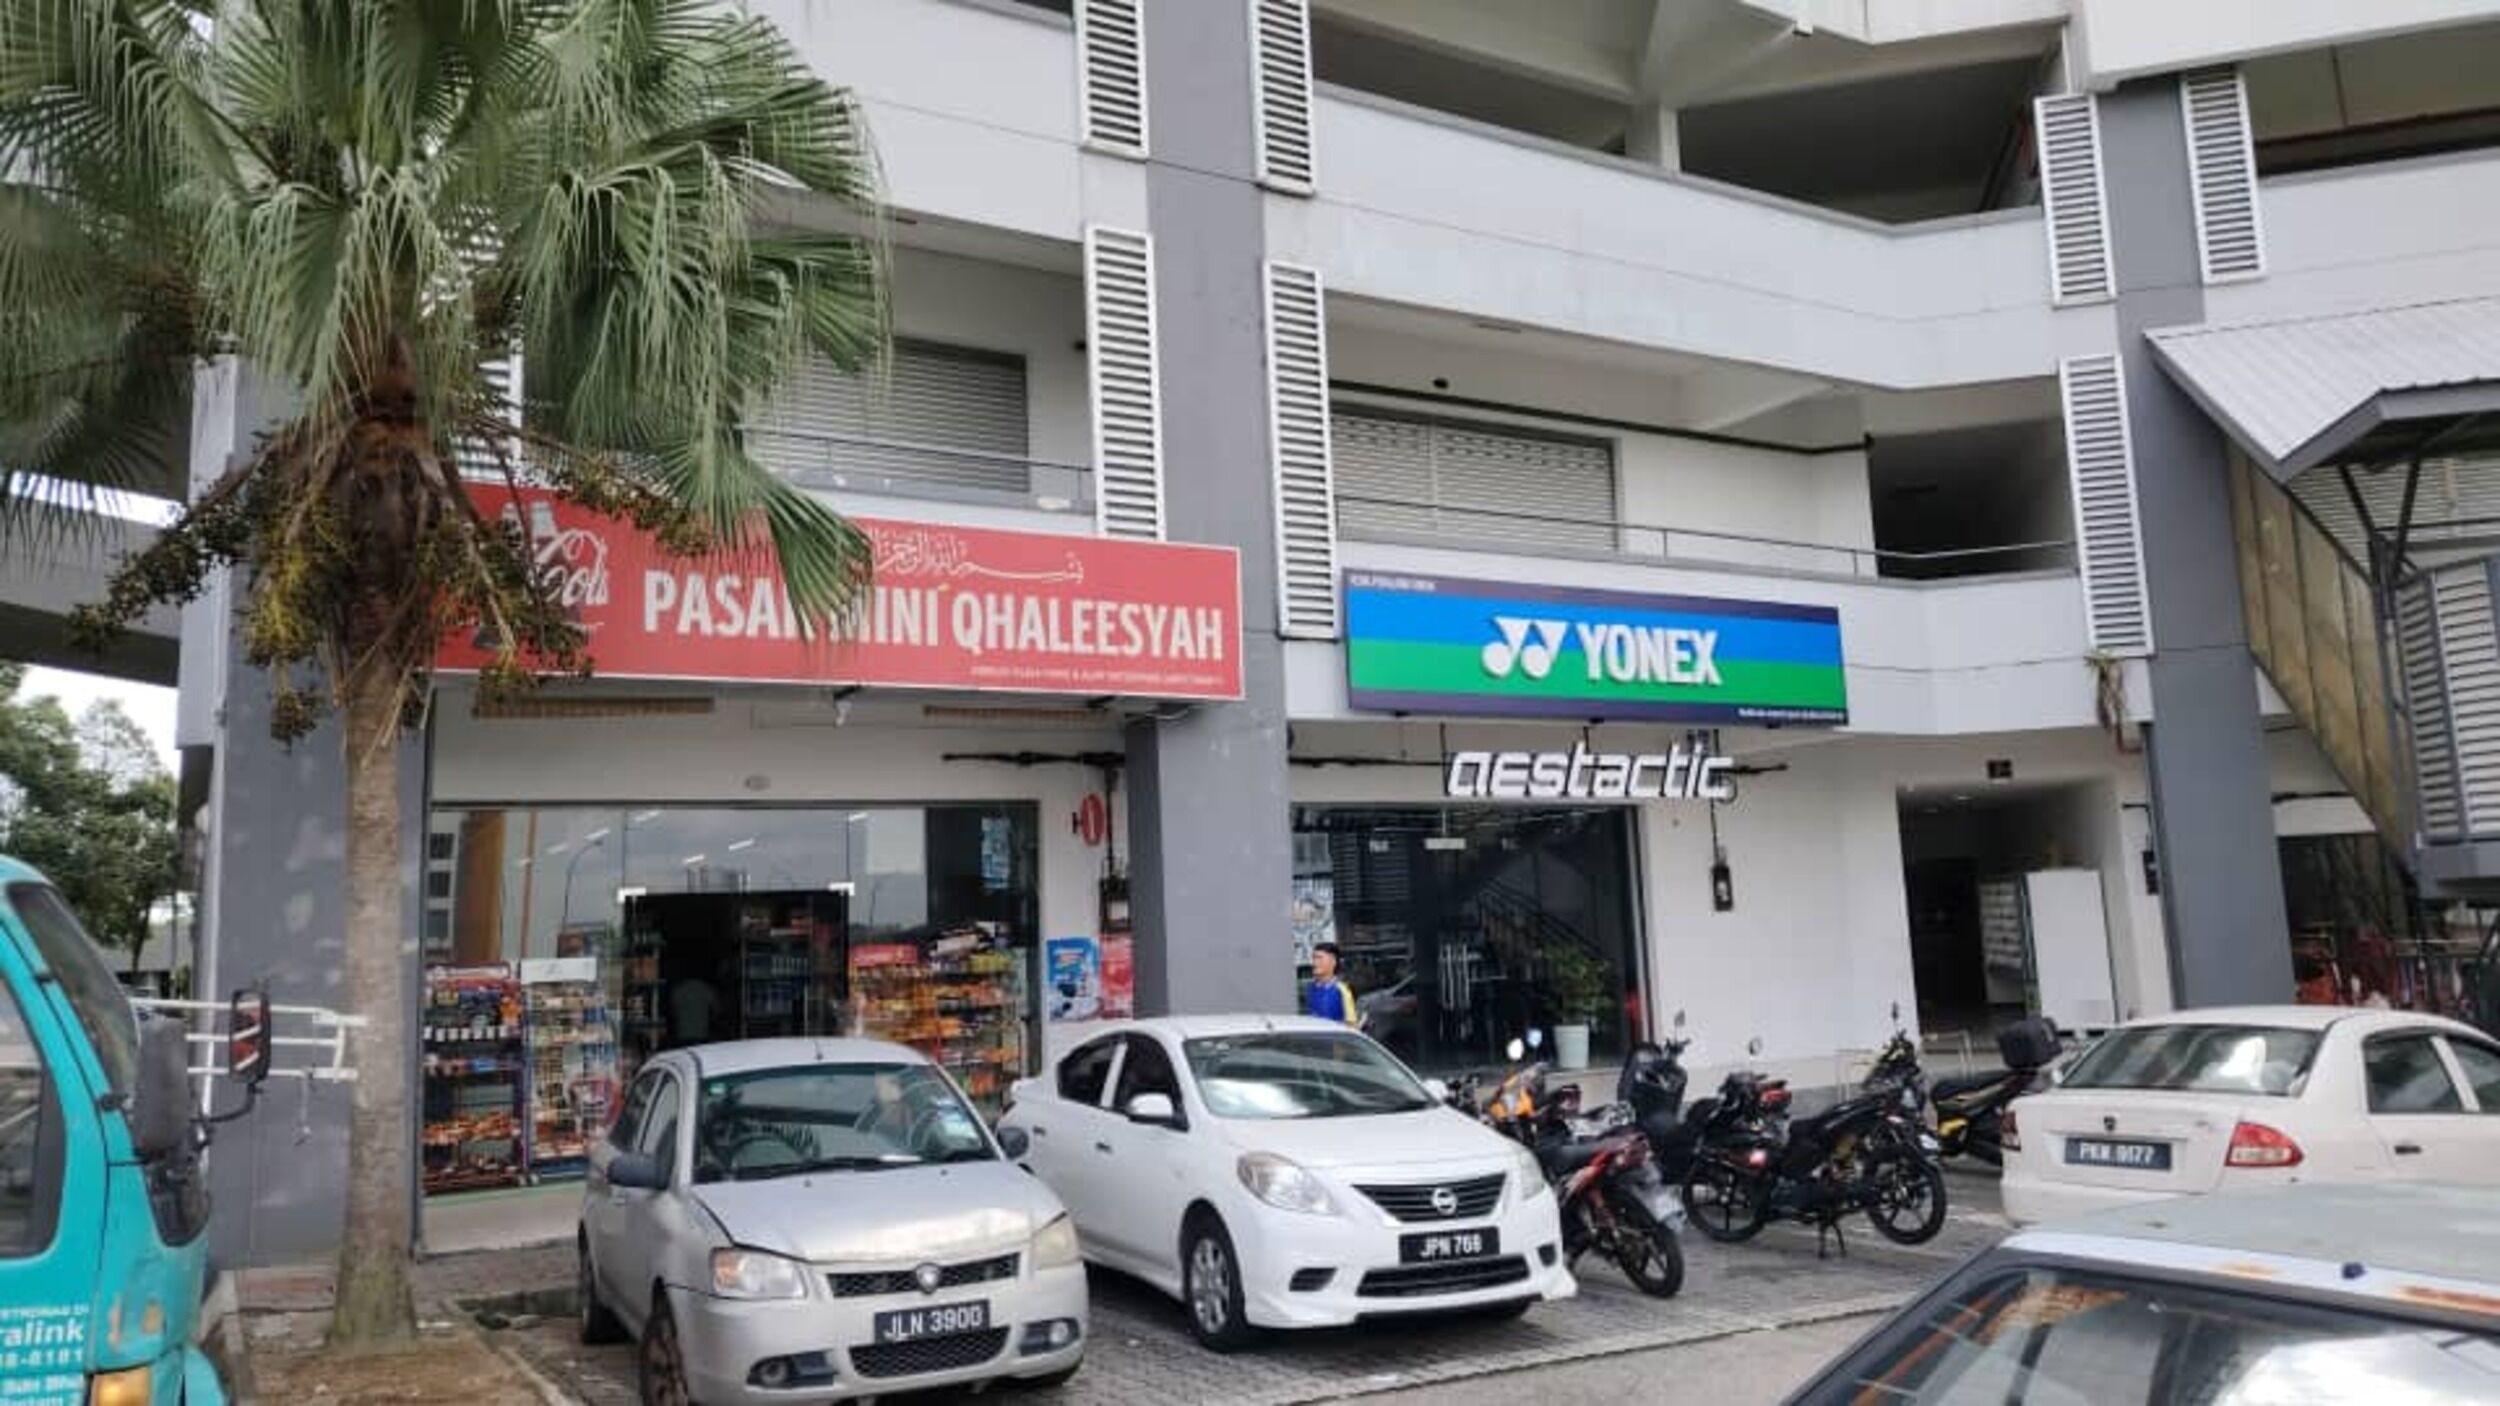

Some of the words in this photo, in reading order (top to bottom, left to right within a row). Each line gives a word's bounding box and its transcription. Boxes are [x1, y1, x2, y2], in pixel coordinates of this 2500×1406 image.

[951, 592, 1223, 661] QHALEESYAH
[1575, 621, 1723, 687] YONEX
[883, 1311, 924, 1340] JLN
[930, 1304, 984, 1333] 3900
